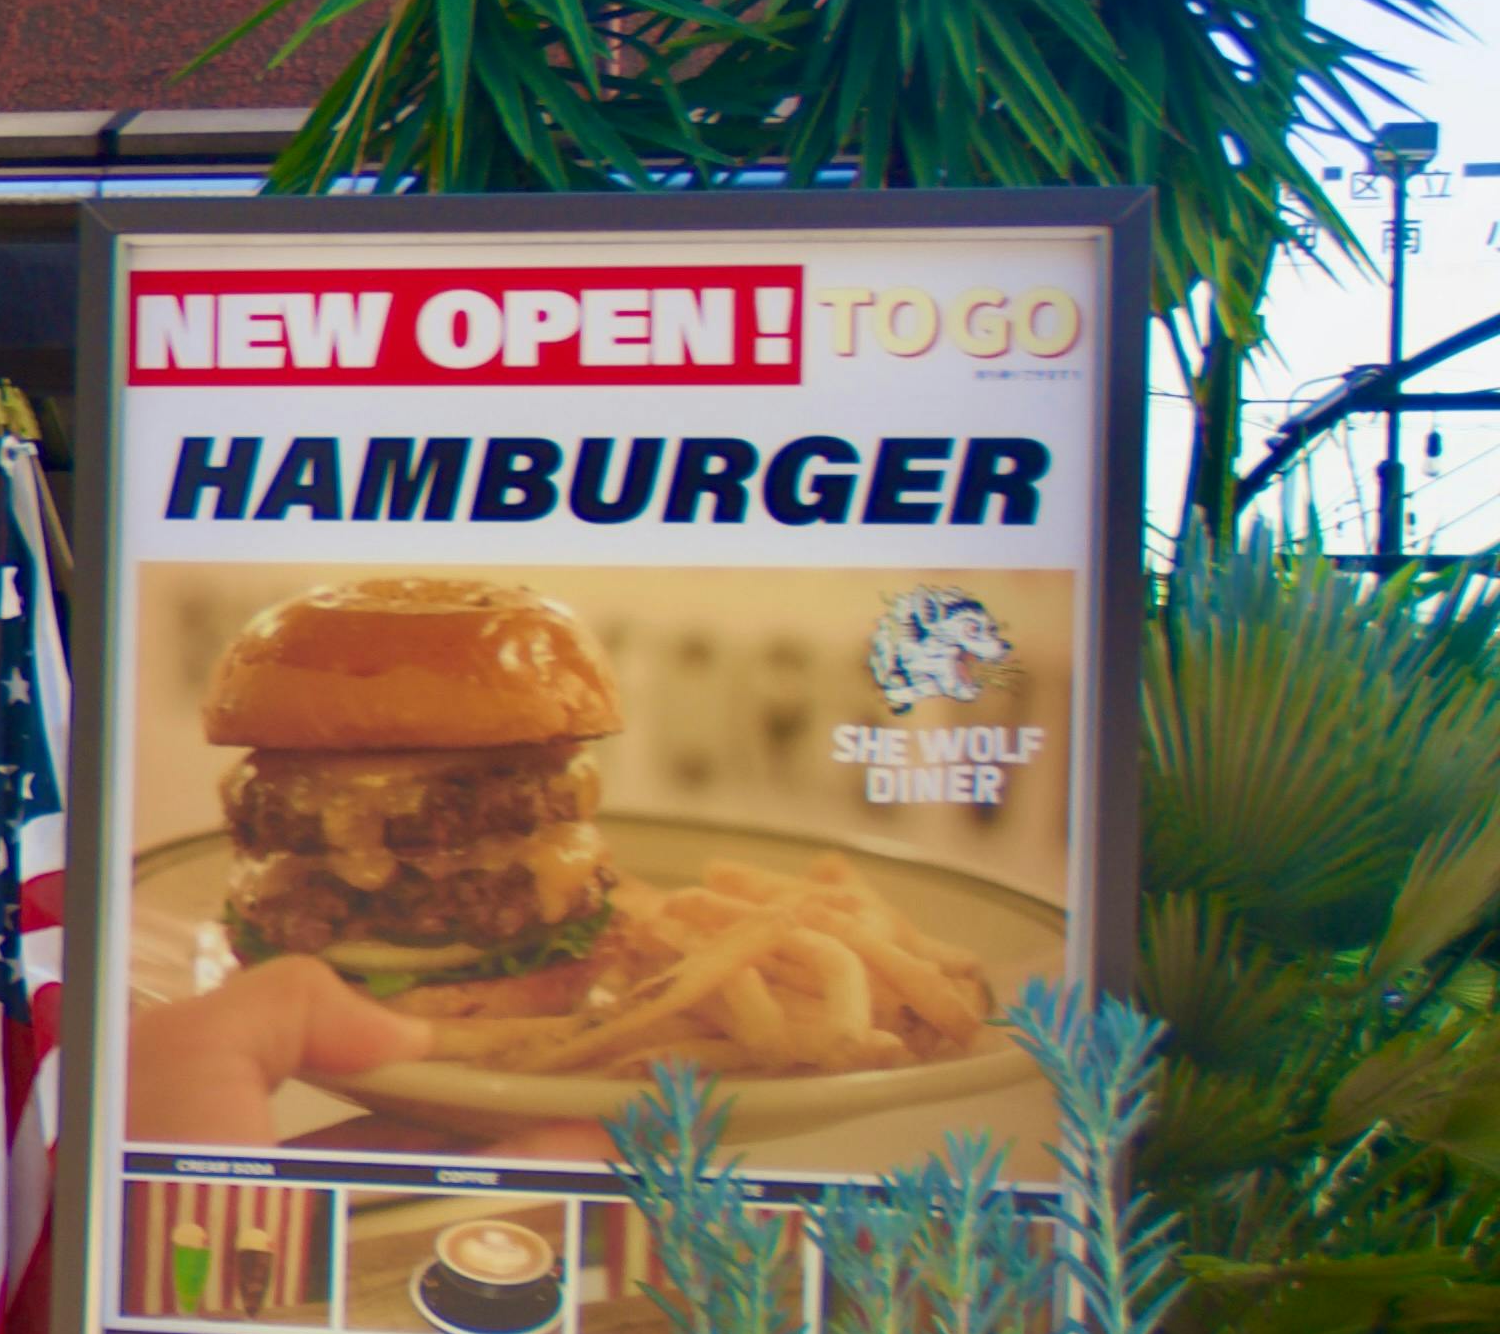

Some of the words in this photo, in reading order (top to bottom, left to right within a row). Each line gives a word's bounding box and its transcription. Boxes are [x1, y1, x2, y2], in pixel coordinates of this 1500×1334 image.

[135, 291, 393, 370] NEW
[817, 286, 940, 358] TO
[949, 285, 1082, 359] GO
[163, 435, 1052, 527] HAMBURGER
[831, 723, 909, 764] SHE
[916, 726, 1045, 764] WOLF
[865, 765, 1004, 804] DINER
